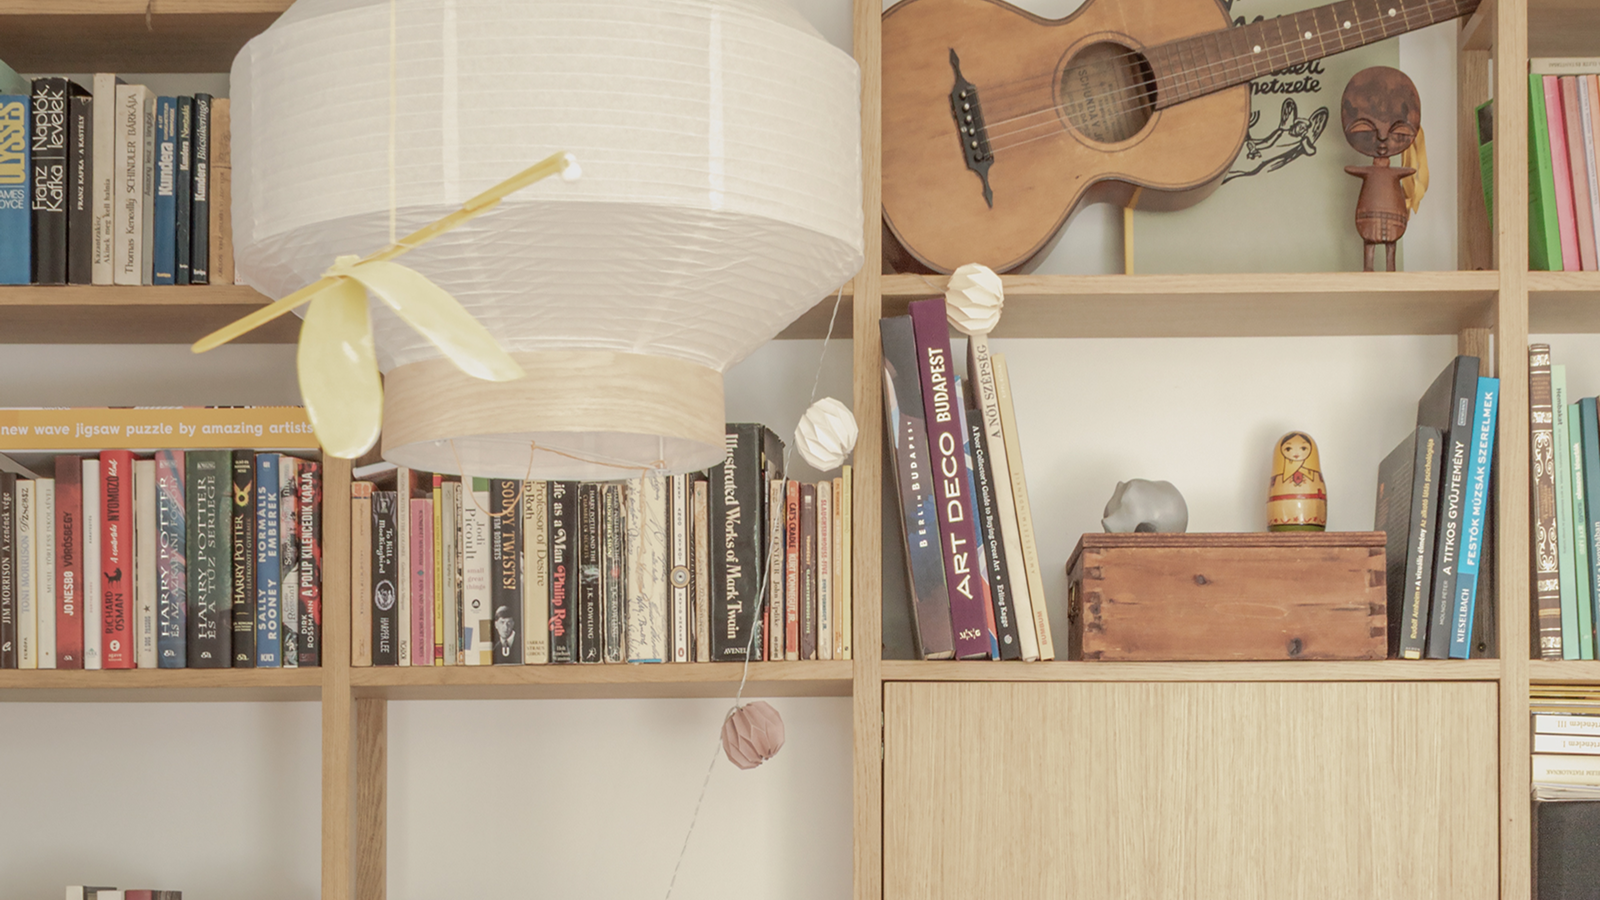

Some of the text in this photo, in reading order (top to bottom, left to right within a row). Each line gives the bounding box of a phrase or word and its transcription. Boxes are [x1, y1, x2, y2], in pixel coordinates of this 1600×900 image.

[32, 84, 50, 151] Naplók,
[47, 90, 63, 149] levelek
[77, 114, 85, 148] KASTÉLY
[180, 141, 189, 171] Kundera
[194, 99, 209, 201] Kundera Búcsúkeringő
[123, 93, 137, 274] Thomas Keneally SCHINDLER BÁRKÁJA
[158, 142, 173, 196] Kundera
[0, 189, 25, 199] AMES
[32, 166, 48, 210] Franz
[46, 165, 63, 212] Kafka
[103, 238, 111, 264] Akinek
[976, 344, 1002, 440] A NŐI SZÉPSÉG
[1, 422, 314, 438] new wave jigsaw puzzle by amazing artists
[974, 432, 982, 448] Poor
[927, 347, 974, 600] ART DECO BUDAPEST
[976, 449, 988, 485] Collector's
[1422, 438, 1435, 482] pszichológiája
[2, 492, 11, 510] vége
[906, 420, 928, 548] BERLIN BUDAPEST
[981, 486, 990, 506] Guide
[1421, 482, 1430, 498] látás
[525, 494, 535, 519] Roth
[554, 502, 564, 516] as
[554, 519, 564, 527] a
[788, 502, 797, 521] CAT'S
[1420, 498, 1429, 519] alkotó
[1420, 520, 1427, 528] Az
[1456, 391, 1494, 643] KIESELBACH FESTŐK MÚZSÁK SZERELMEK
[2, 511, 11, 544] zenének
[62, 511, 73, 567] VÖRÖSBEGY
[257, 486, 266, 563] NORMÁLIS
[267, 492, 277, 557] EMBEREK
[301, 472, 313, 597] A POLIP KILENCEDIK KARJA
[385, 528, 393, 538] To
[465, 508, 476, 561] Picoult
[476, 521, 485, 545] Jodi
[501, 480, 516, 590] SOUPY TWISTS!
[535, 480, 547, 586] Professor of Desire
[723, 433, 743, 639] Illustrated Works of Mark Twain
[788, 522, 797, 548] CRADLE
[820, 499, 828, 575] SLAUGHTERHOUSE-FIVE
[985, 515, 997, 539] Buying
[1415, 528, 1427, 554] élmény
[1439, 440, 1466, 626] MOLNOS PÉTER A TITKOS GYŰJTEMÉNY
[111, 556, 119, 564] A
[159, 475, 170, 637] HARRY POTTER
[169, 475, 180, 637] ÉS AZ AZKABANI FOGOLY
[197, 476, 208, 639] HARRY POTTER
[206, 475, 217, 639] ÉS A TŰZ SERLEGE
[234, 513, 245, 604] HARRY POTTER
[376, 519, 386, 574] Mockingbird
[385, 541, 394, 558] Kill
[493, 531, 502, 560] ROBERTS
[554, 528, 566, 563] Man
[788, 553, 797, 571] KURT
[990, 540, 999, 559] Great
[1, 556, 11, 607] MORRISON
[21, 535, 30, 614] TONI MORRISON
[467, 576, 484, 584] great
[1414, 555, 1424, 580] vizuális
[466, 584, 486, 592] things
[552, 565, 566, 606] Philip
[773, 580, 781, 599] John
[996, 584, 1006, 606] Erling
[1, 609, 11, 624] JIM
[63, 603, 74, 616] JO
[115, 593, 124, 631] OSMAN
[258, 588, 266, 631] SALLY
[268, 578, 278, 640] ROONEY
[773, 600, 781, 627] Updike
[999, 606, 1010, 628] Kagge
[1411, 591, 1421, 618] Arnheim
[306, 600, 314, 649] ROSSMANN
[380, 617, 390, 653] HARPER LEE
[548, 608, 566, 637] Roth
[1036, 610, 1048, 646] BUMBUM
[1409, 619, 1420, 639] Rudolf
